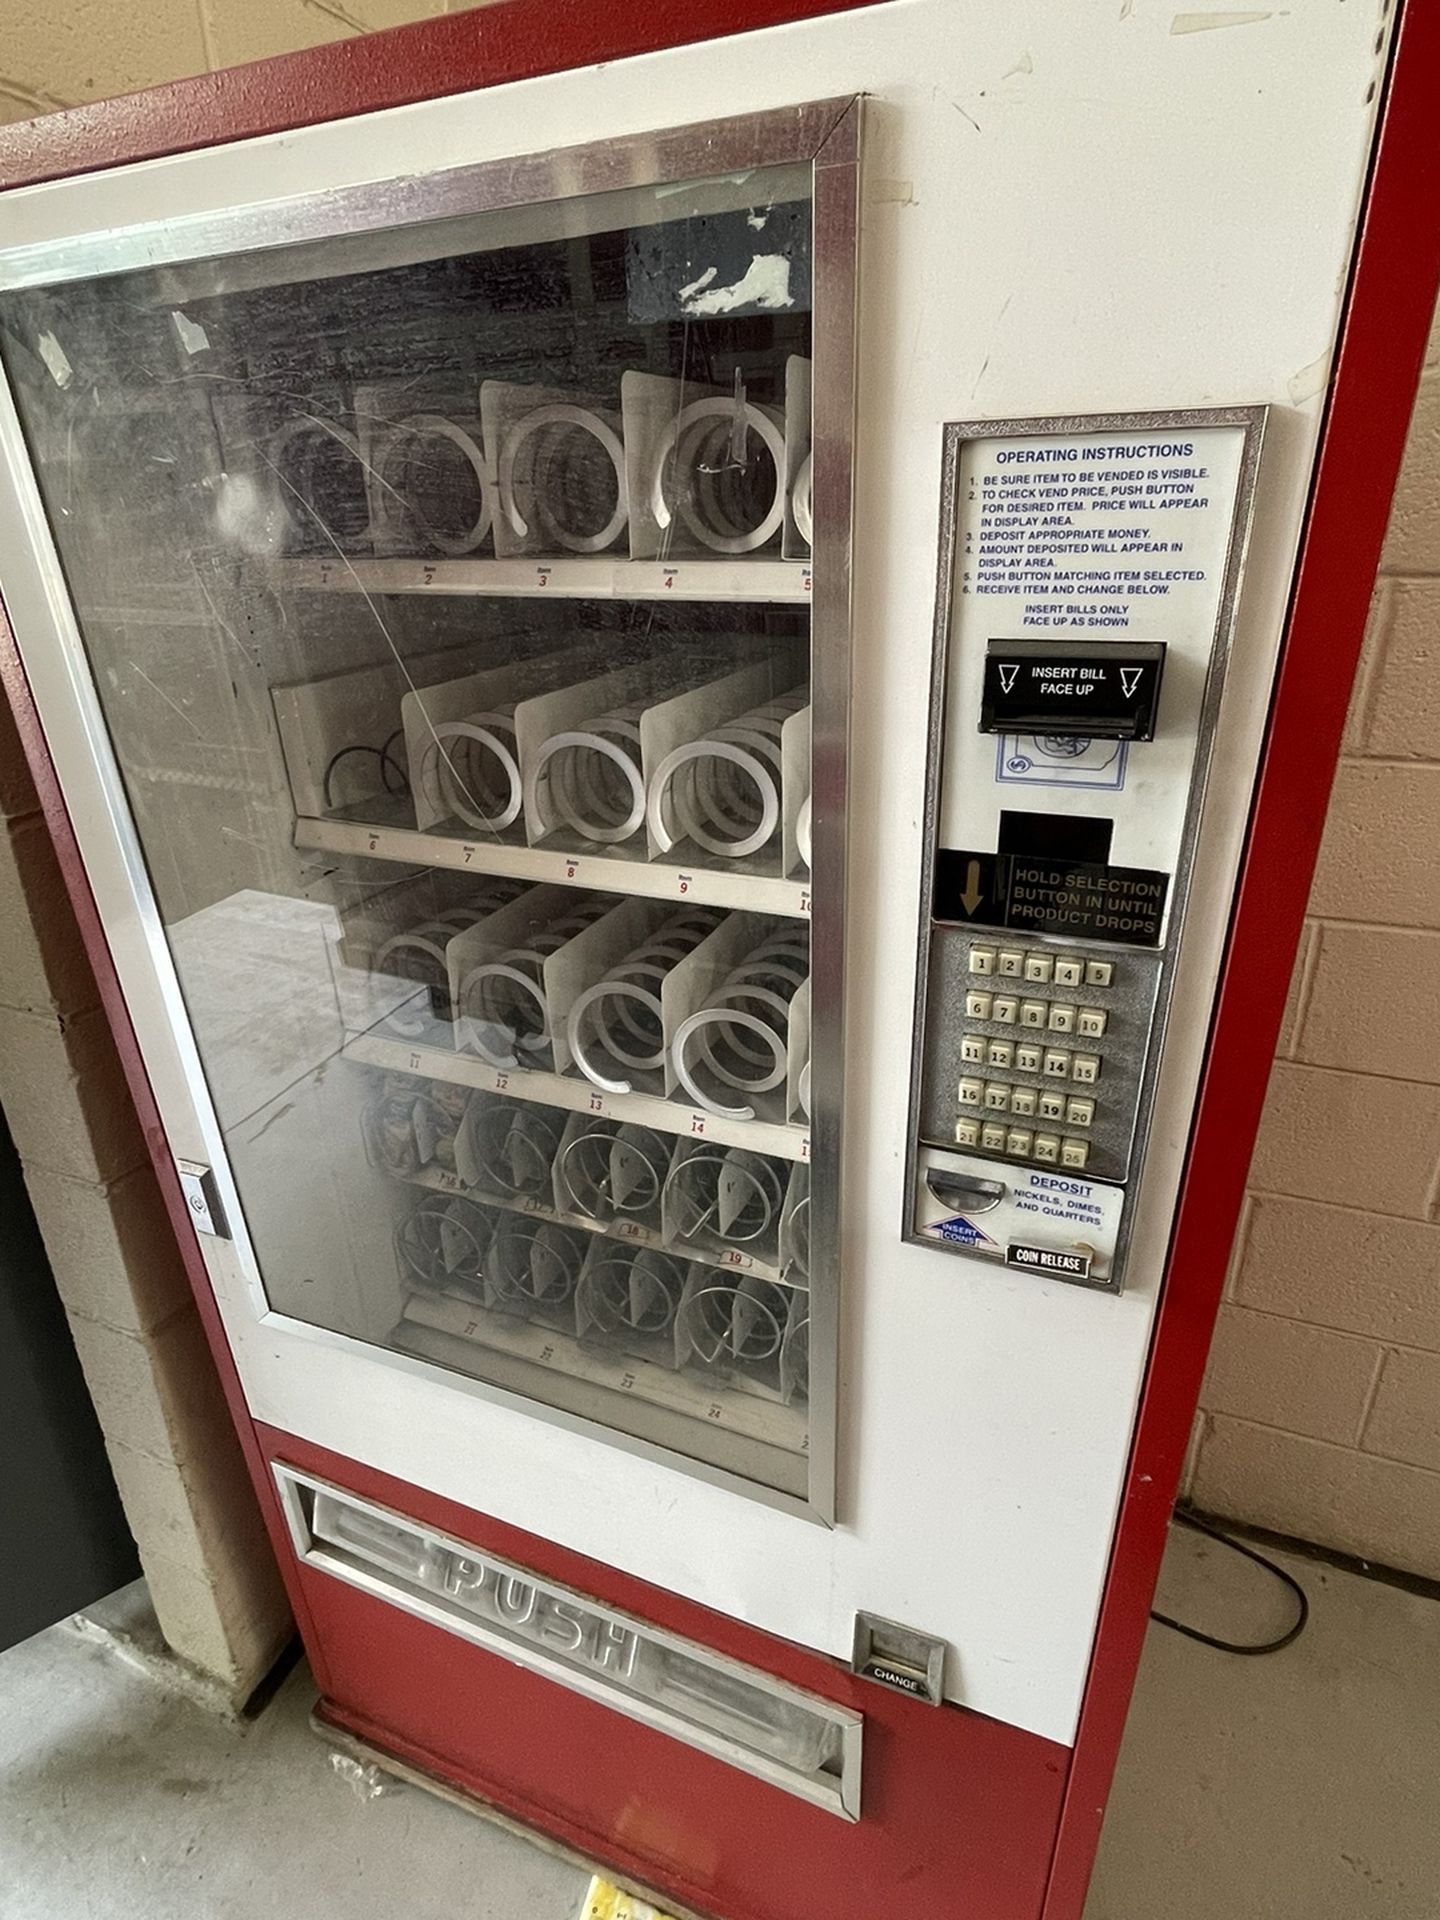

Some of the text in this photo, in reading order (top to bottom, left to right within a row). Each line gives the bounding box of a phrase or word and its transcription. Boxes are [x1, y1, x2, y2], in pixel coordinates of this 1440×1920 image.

[996, 444, 1194, 464] OPERATING INSTRUCTIONS
[984, 476, 998, 486] BE
[1001, 474, 1030, 485] SURE
[1034, 474, 1060, 484] ITEM
[1062, 472, 1076, 482] TO
[1079, 472, 1094, 482] BE
[1098, 470, 1144, 480] VENDED
[1148, 470, 1158, 480] IS
[1162, 468, 1210, 479] VISIBLE.
[982, 490, 996, 500] TO
[998, 488, 1036, 499] CHECK
[1039, 487, 1068, 498] VEND
[1072, 486, 1108, 498] PRICE,
[1111, 485, 1142, 496] PUSH
[1146, 484, 1194, 494] BUTTON
[982, 498, 1208, 513] FOR DESIRED ITEM. PRICE WILL APPEAR
[981, 516, 1075, 527] IN DISPLAY AREA.
[980, 531, 1025, 541] DEPOSIT
[1028, 530, 1104, 540] APPROPRIATE
[1108, 528, 1150, 538] MONEY.
[979, 545, 1024, 554] AMOUNT
[1027, 544, 1088, 554] DEPOSITED
[1091, 544, 1118, 552] WILL
[1120, 543, 1168, 552] APPEAR
[1172, 542, 1183, 552] IN
[978, 558, 1022, 568] DISPLAY
[425, 574, 432, 585] 2
[539, 576, 547, 586] 3
[977, 572, 1006, 581] PUSH
[1008, 572, 1052, 580] BUTTON
[1054, 571, 1110, 580] MATCHING
[1114, 571, 1140, 580] ITEM
[1144, 570, 1206, 580] SELECTED.
[665, 577, 672, 588] 4
[804, 579, 811, 590] 5
[976, 585, 1020, 594] RECEIVE
[1024, 585, 1048, 594] ITEM
[1052, 585, 1074, 594] AND
[1077, 584, 1124, 594] CHANGE
[1127, 585, 1170, 594] BELOW.
[1025, 604, 1129, 614] INSERT BILLS ONLY
[1024, 616, 1128, 626] FACE UP AS SHOWN
[1032, 667, 1106, 680] INSERT BILL
[1040, 683, 1094, 695] FACE UP
[370, 840, 376, 850] 6
[465, 853, 472, 864] 7
[568, 867, 575, 878] 8
[680, 882, 688, 894] 9
[1016, 868, 1162, 898] HOLD SELECTION
[1014, 887, 1157, 917] BUTTON IN UNTIL
[1012, 904, 1155, 934] PRODUCT DROPS
[979, 959, 986, 968] 1
[1007, 961, 1014, 971] 2
[1034, 967, 1041, 977] 3
[1064, 970, 1072, 980] 4
[1096, 970, 1103, 980] 5
[974, 1004, 981, 1014] 6
[1001, 1008, 1008, 1018] 7
[1030, 1012, 1037, 1022] 8
[1058, 1017, 1066, 1027] 9
[1082, 1021, 1098, 1032] 10
[966, 1048, 978, 1058] 11
[992, 1052, 1006, 1062] 12
[409, 1059, 420, 1070] 11
[1021, 1056, 1036, 1068] 13
[1050, 1062, 1064, 1072] 14
[1078, 1067, 1092, 1078] 15
[496, 1078, 508, 1090] 12
[962, 1090, 976, 1100] 16
[590, 1100, 602, 1110] 13
[992, 1096, 1005, 1106] 17
[1016, 1102, 1030, 1112] 18
[1044, 1104, 1058, 1116] 19
[1072, 1112, 1087, 1123] 20
[691, 1122, 704, 1134] 14
[960, 1132, 974, 1142] 21
[986, 1136, 1000, 1146] 22
[1012, 1140, 1026, 1150] 23
[1038, 1146, 1052, 1157] 24
[1066, 1154, 1080, 1164] 25
[1030, 1175, 1093, 1197] DEPOSIT
[1016, 1201, 1038, 1214] AND
[627, 1225, 640, 1235] 18
[942, 1223, 976, 1236] INSERT
[944, 1231, 974, 1244] COINS
[728, 1252, 742, 1264] 19
[1016, 1249, 1080, 1271] COIN RELEASE
[708, 1409, 720, 1419] 24
[444, 1560, 639, 1677] PUSH
[874, 1668, 918, 1691] CHANGE
